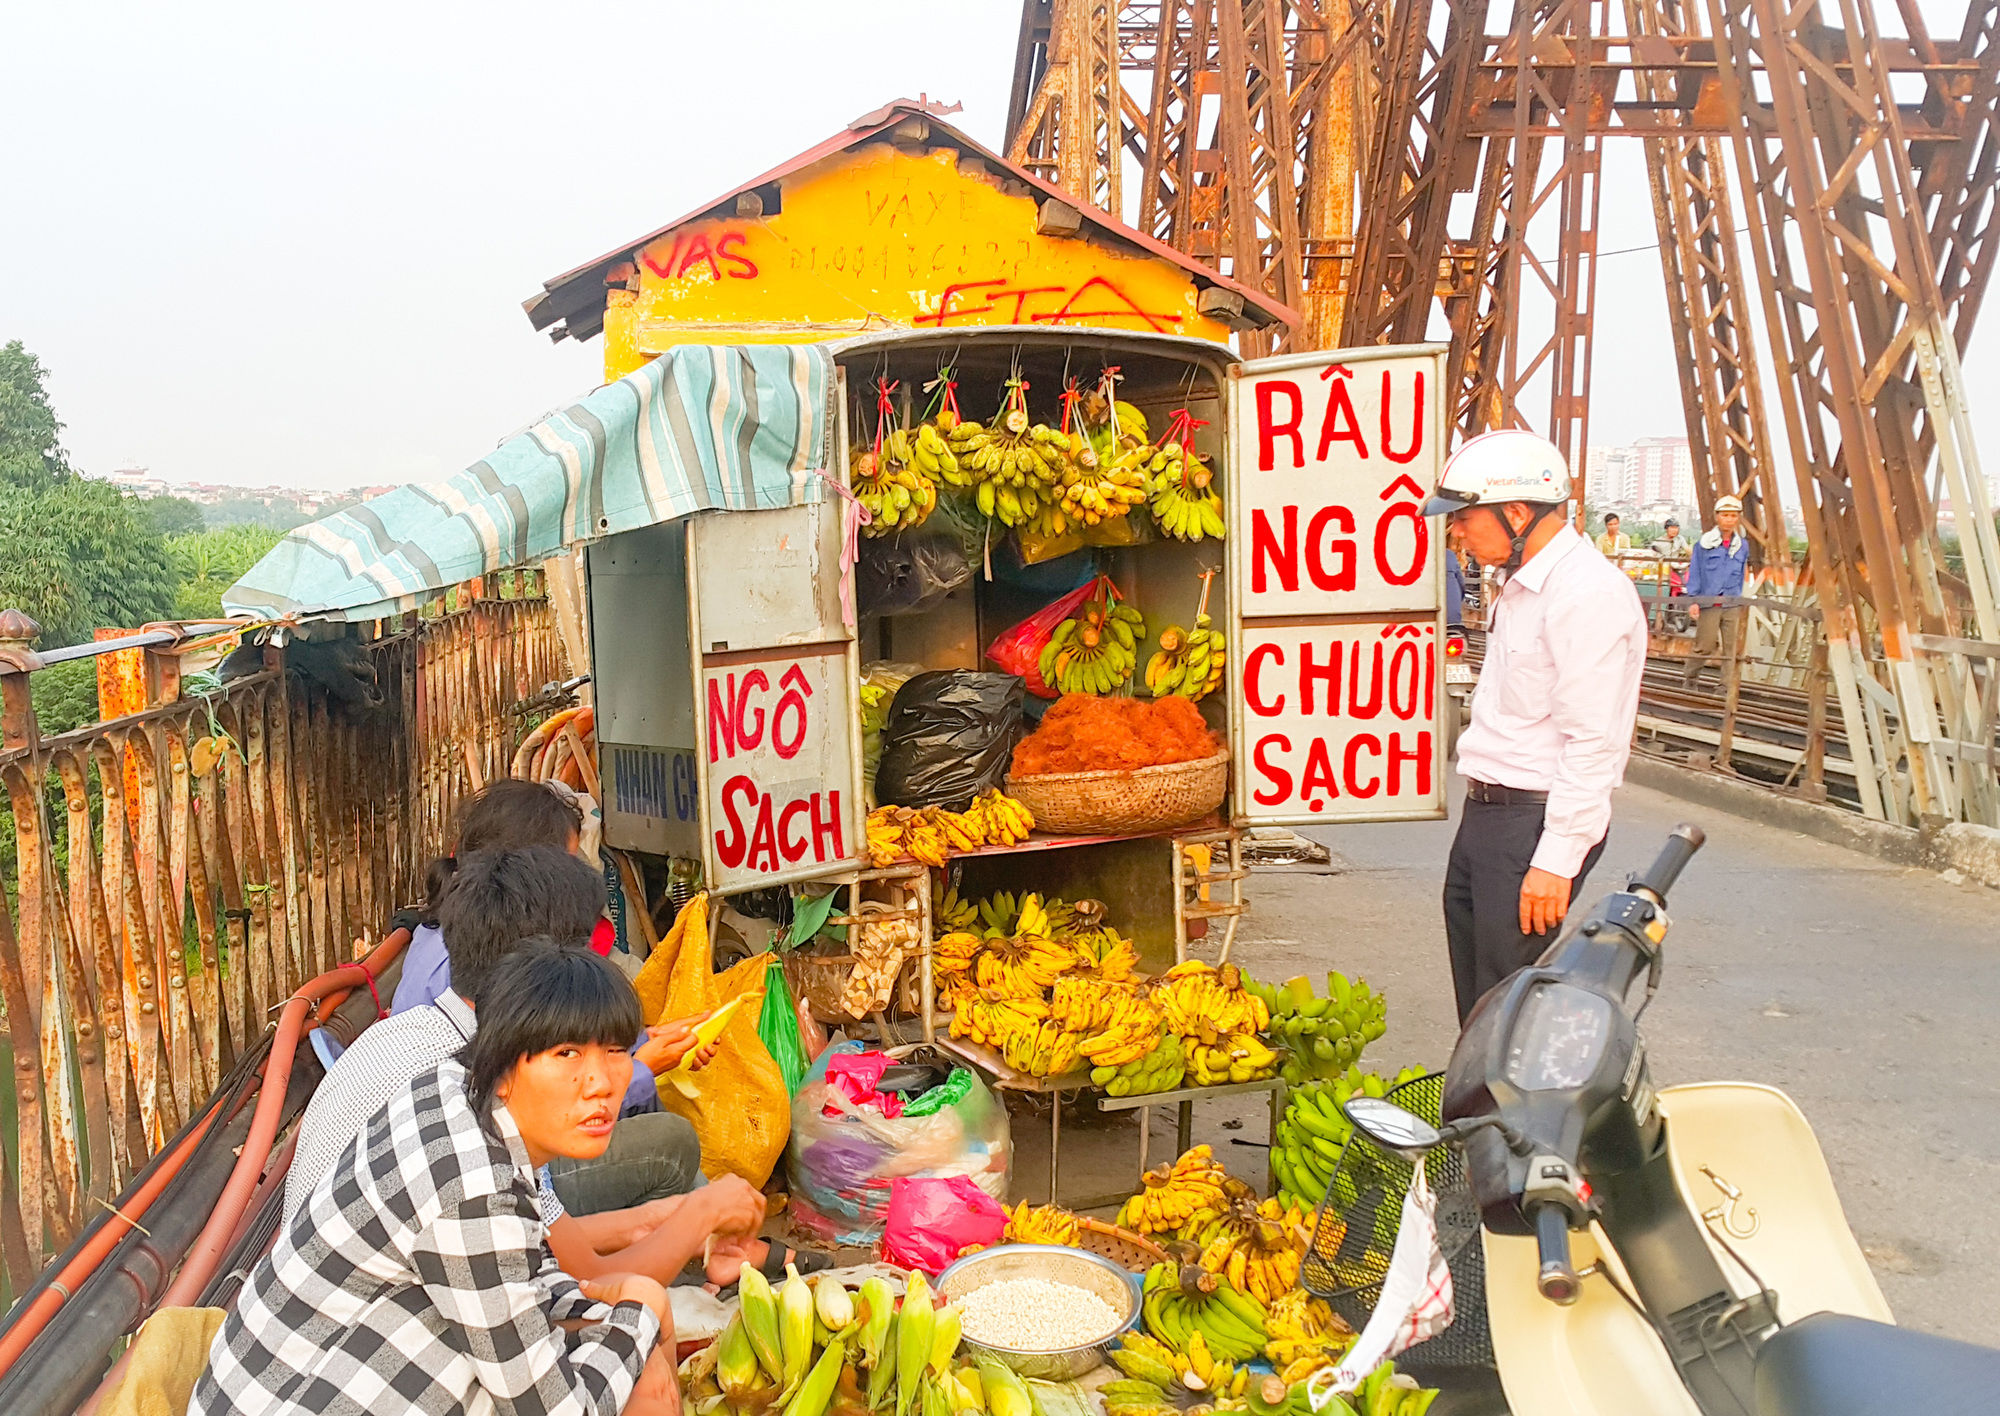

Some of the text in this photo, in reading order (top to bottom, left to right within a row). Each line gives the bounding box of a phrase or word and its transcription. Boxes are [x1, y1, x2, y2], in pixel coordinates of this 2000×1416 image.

[641, 231, 759, 281] VAS
[1255, 363, 1425, 472] RÂU
[1251, 473, 1429, 594] NGÔ
[708, 662, 813, 764] NGÔ
[1252, 731, 1432, 812] SẠCH
[714, 774, 845, 873] SẠCH
